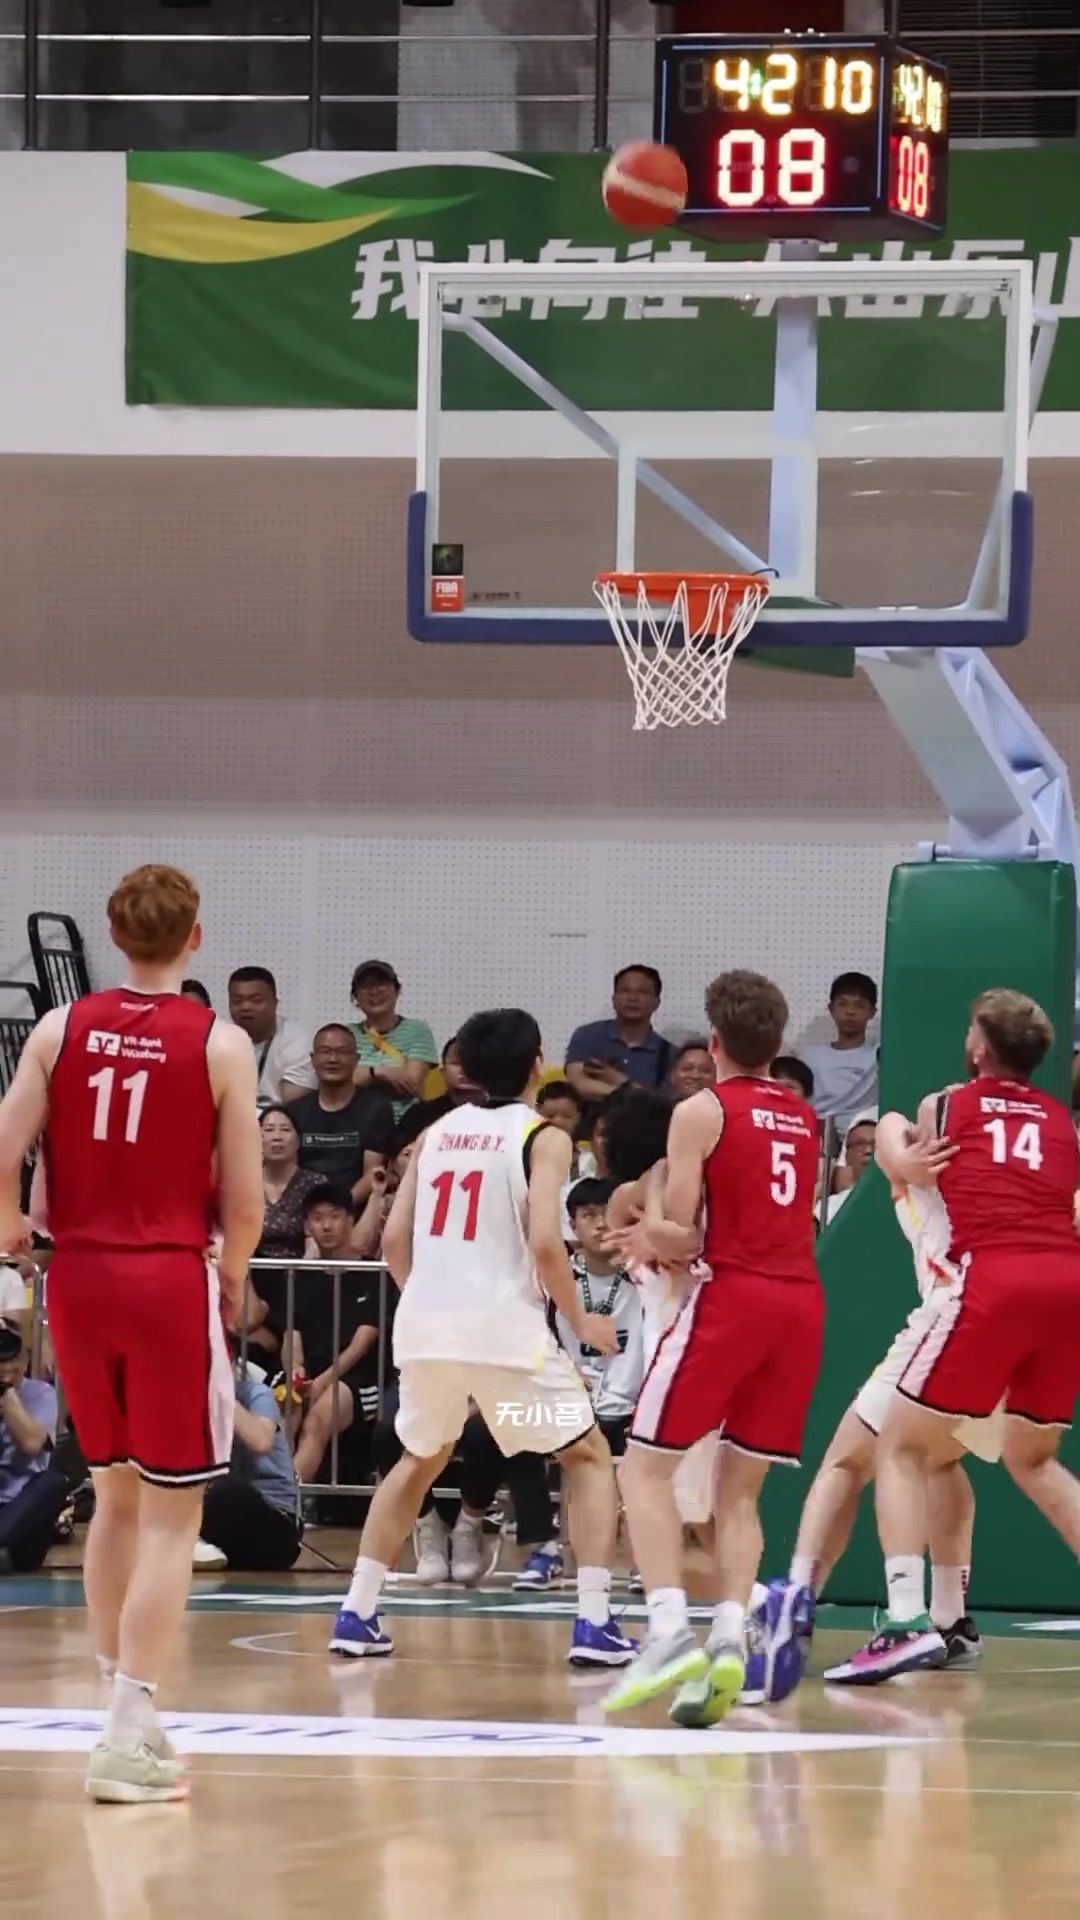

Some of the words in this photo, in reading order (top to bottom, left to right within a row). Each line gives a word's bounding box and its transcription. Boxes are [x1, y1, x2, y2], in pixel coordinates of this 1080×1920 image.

[717, 128, 826, 207] 08
[898, 135, 929, 218] 08
[436, 581, 458, 593] FIBA
[88, 1066, 149, 1144] 11
[438, 1133, 480, 1152] ZHANG
[770, 1140, 797, 1207] 5
[983, 1118, 1044, 1171] 14
[429, 1170, 484, 1241] 11
